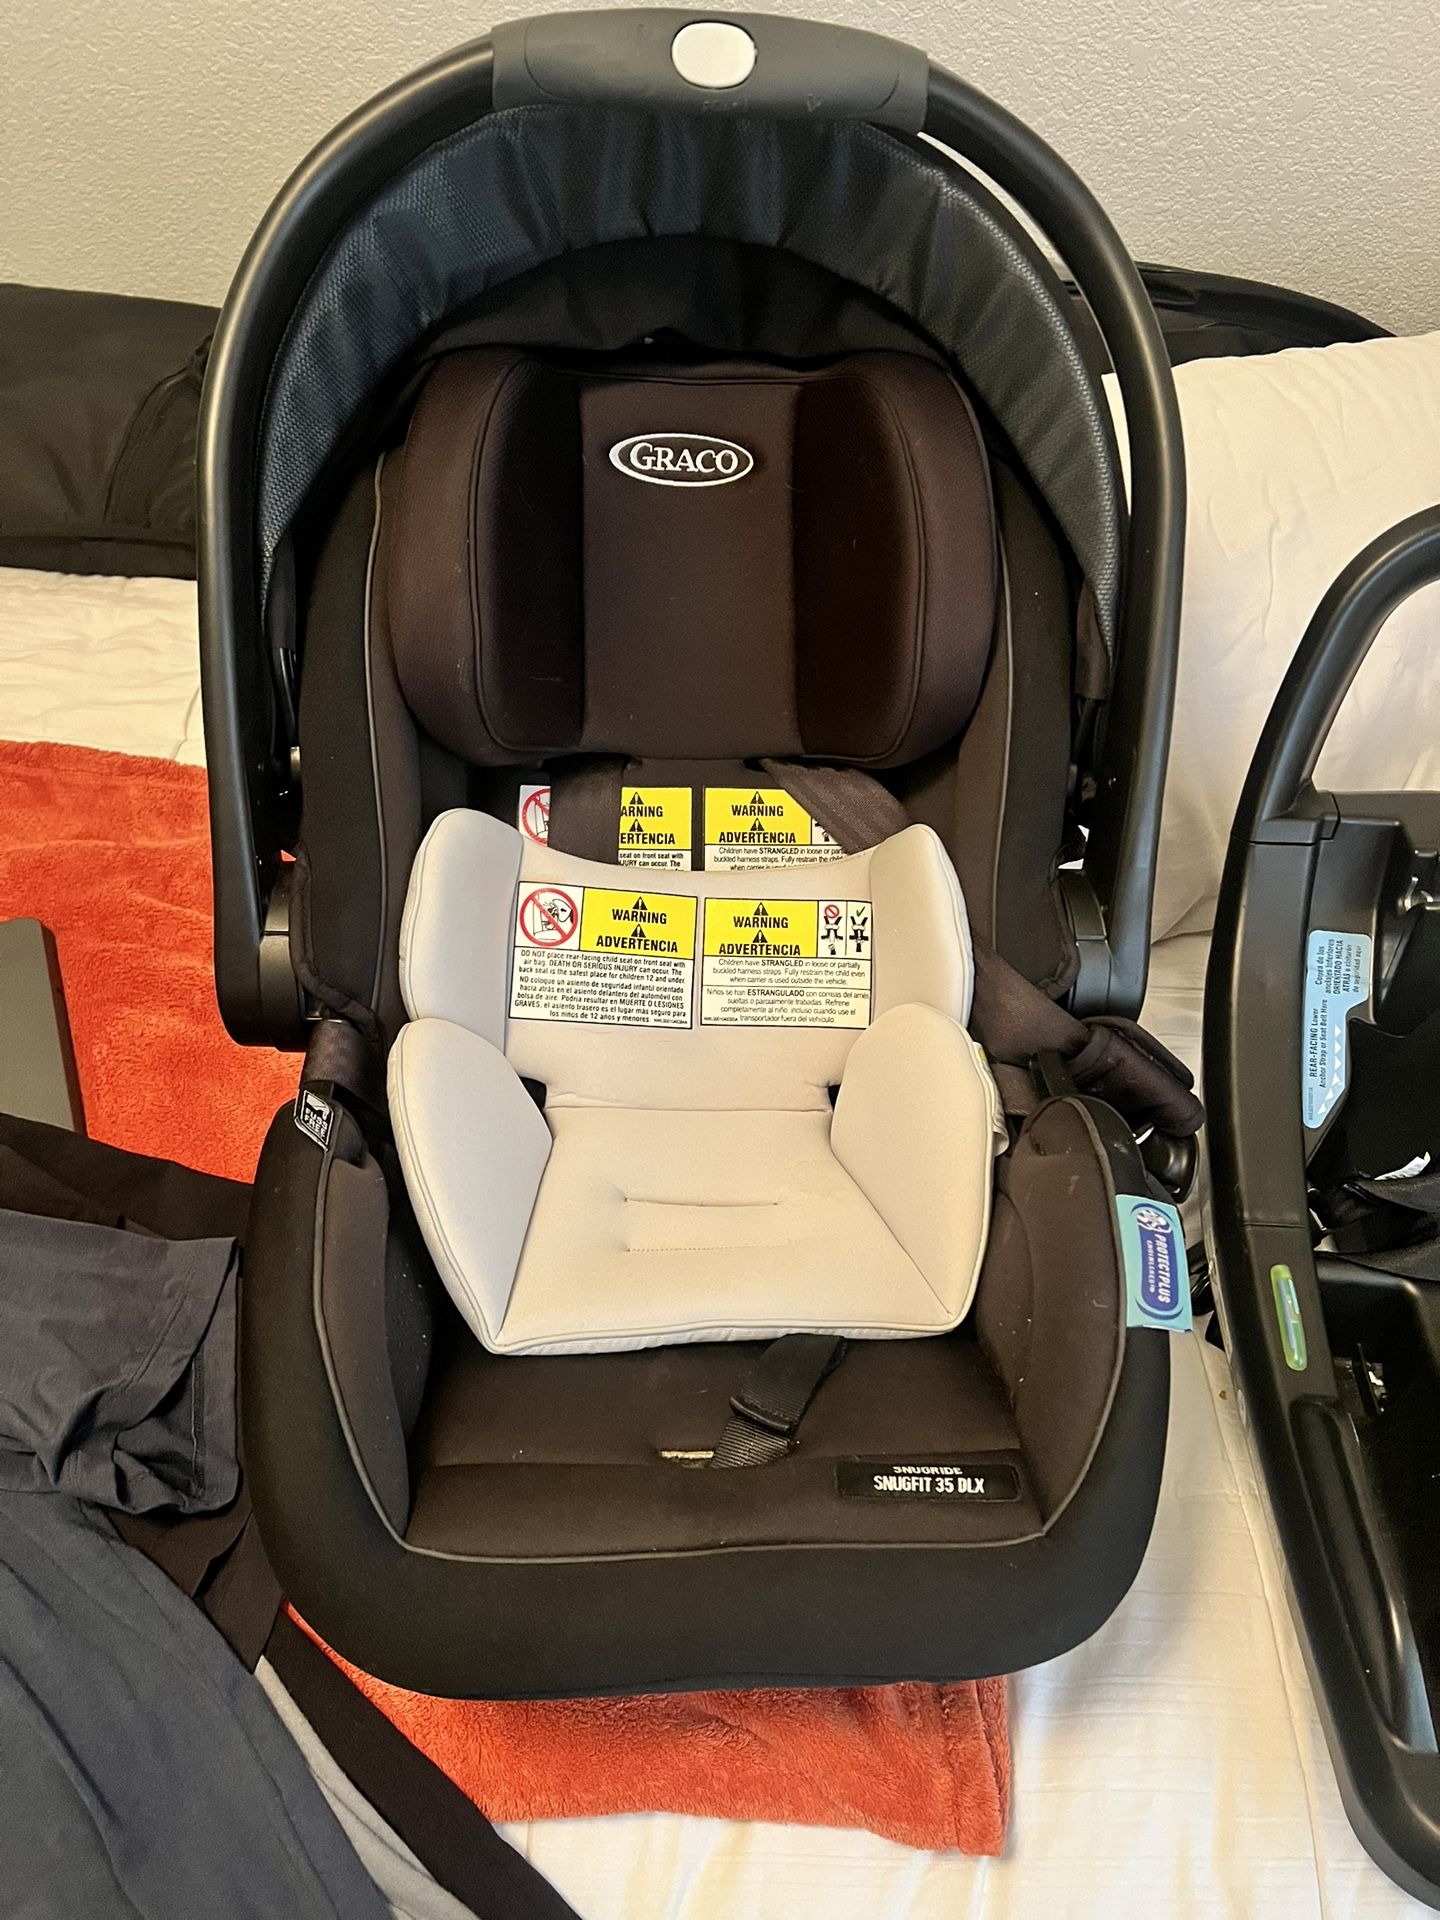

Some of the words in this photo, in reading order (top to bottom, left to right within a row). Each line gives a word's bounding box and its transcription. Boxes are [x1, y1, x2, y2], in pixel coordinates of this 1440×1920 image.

[630, 442, 739, 474] GRACO
[621, 806, 663, 817] ARNING
[732, 805, 783, 816] WARNING
[620, 833, 675, 845] ERTENCIA
[719, 832, 796, 843] ADVERTENCIA
[781, 856, 795, 864] Fully
[612, 909, 667, 924] WARNING
[733, 916, 788, 929] WARNING
[596, 935, 678, 953] ADVERTENCIA
[719, 943, 801, 956] ADVERTENCIA
[1316, 946, 1324, 955] los
[1335, 940, 1343, 959] HACIA
[566, 954, 601, 963] rear-facing
[1316, 956, 1323, 964] de
[583, 962, 612, 970] SERIOUS
[784, 968, 799, 976] Fully
[1333, 960, 1342, 995] ORIENTADO
[598, 989, 627, 997] delantero
[617, 1006, 634, 1014] lugar
[619, 998, 646, 1006] MUERTE
[653, 1000, 684, 1009] LESIONES
[1320, 999, 1328, 1013] Here
[1311, 1008, 1319, 1026] Lower
[1309, 1028, 1318, 1077] REAR-FACING
[1320, 1049, 1328, 1066] Strap
[1319, 1067, 1327, 1088] Anchor
[305, 1108, 328, 1130] FUSS
[304, 1115, 326, 1138] FREE
[1154, 1234, 1171, 1304] PROTECTPLUS
[893, 1466, 963, 1475] SNUGRIDE
[874, 1475, 932, 1492] SNUGFIT
[936, 1477, 954, 1493] 35
[958, 1478, 985, 1494] DLX
